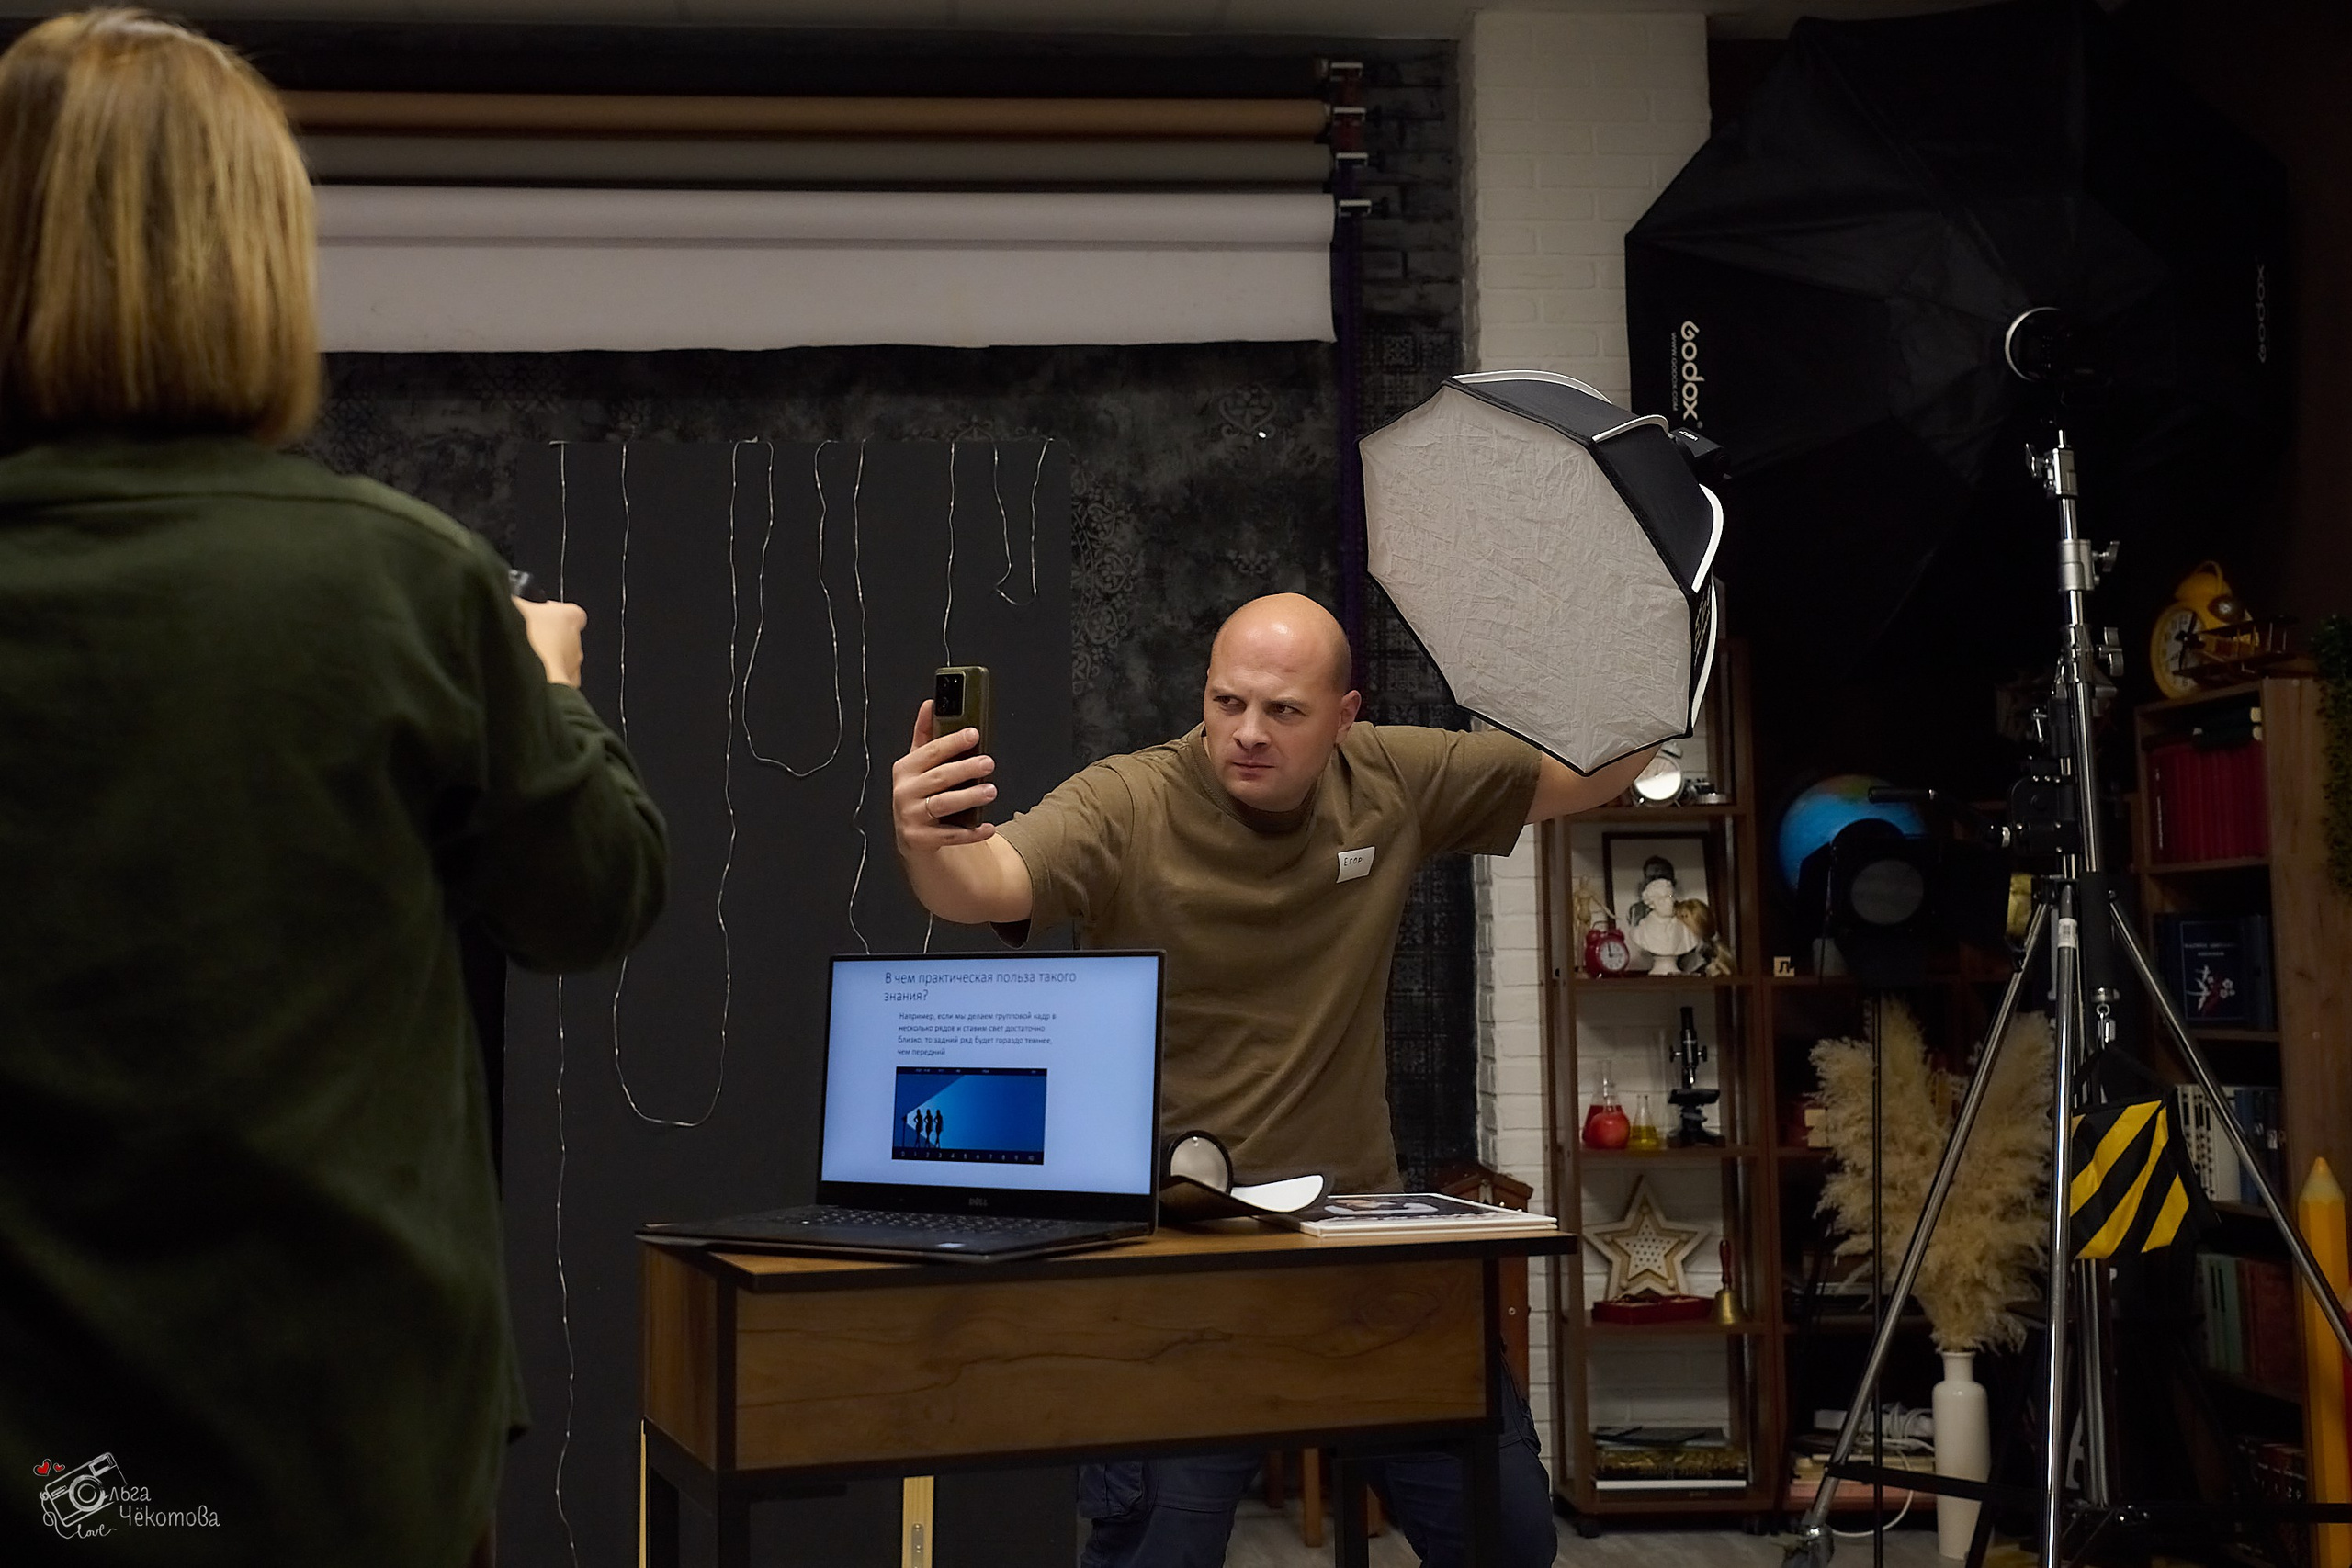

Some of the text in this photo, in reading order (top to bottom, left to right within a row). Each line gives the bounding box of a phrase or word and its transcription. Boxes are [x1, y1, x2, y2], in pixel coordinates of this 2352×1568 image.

[1680, 320, 1705, 422] Godox
[885, 972, 1077, 986] В чем практическая польза такого
[884, 988, 929, 1001] знания?
[899, 1013, 936, 1021] Например,
[995, 1011, 1032, 1021] групповой
[898, 1035, 923, 1044] близко,
[975, 1035, 993, 1044] будет
[911, 1048, 945, 1056] передний
